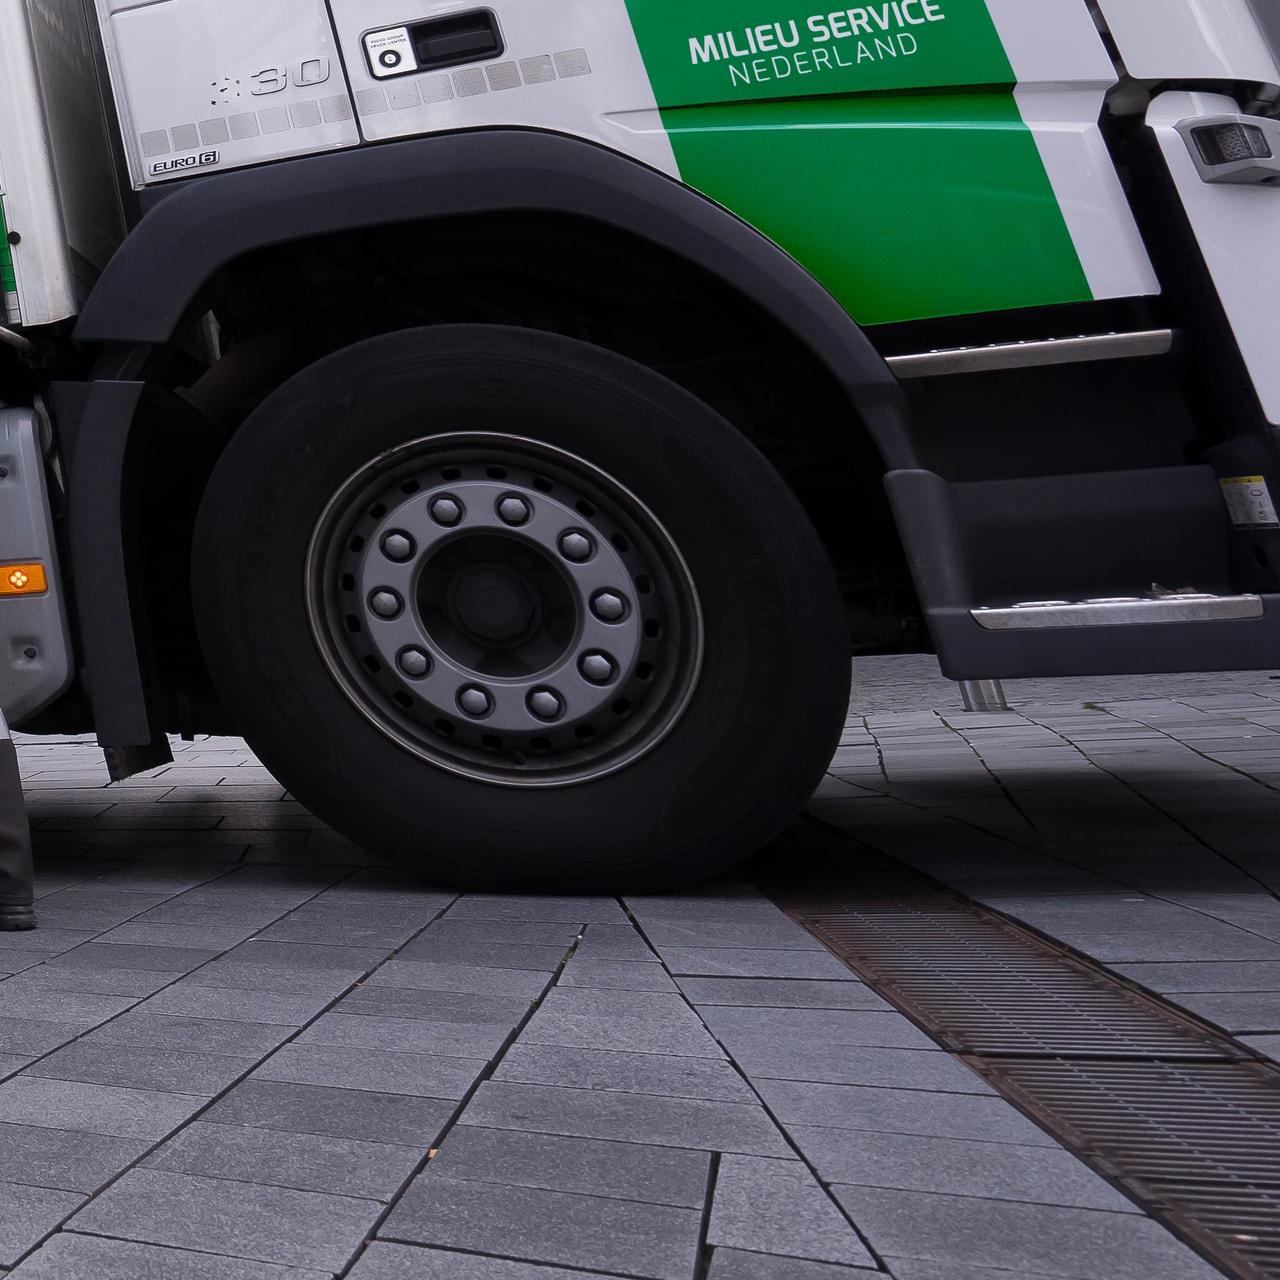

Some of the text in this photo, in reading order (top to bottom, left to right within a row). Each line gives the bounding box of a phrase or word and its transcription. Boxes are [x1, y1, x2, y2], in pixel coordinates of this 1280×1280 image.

[688, 20, 800, 65] MILIEU
[728, 32, 918, 87] NEDERLAND
[153, 156, 196, 173] EURO
